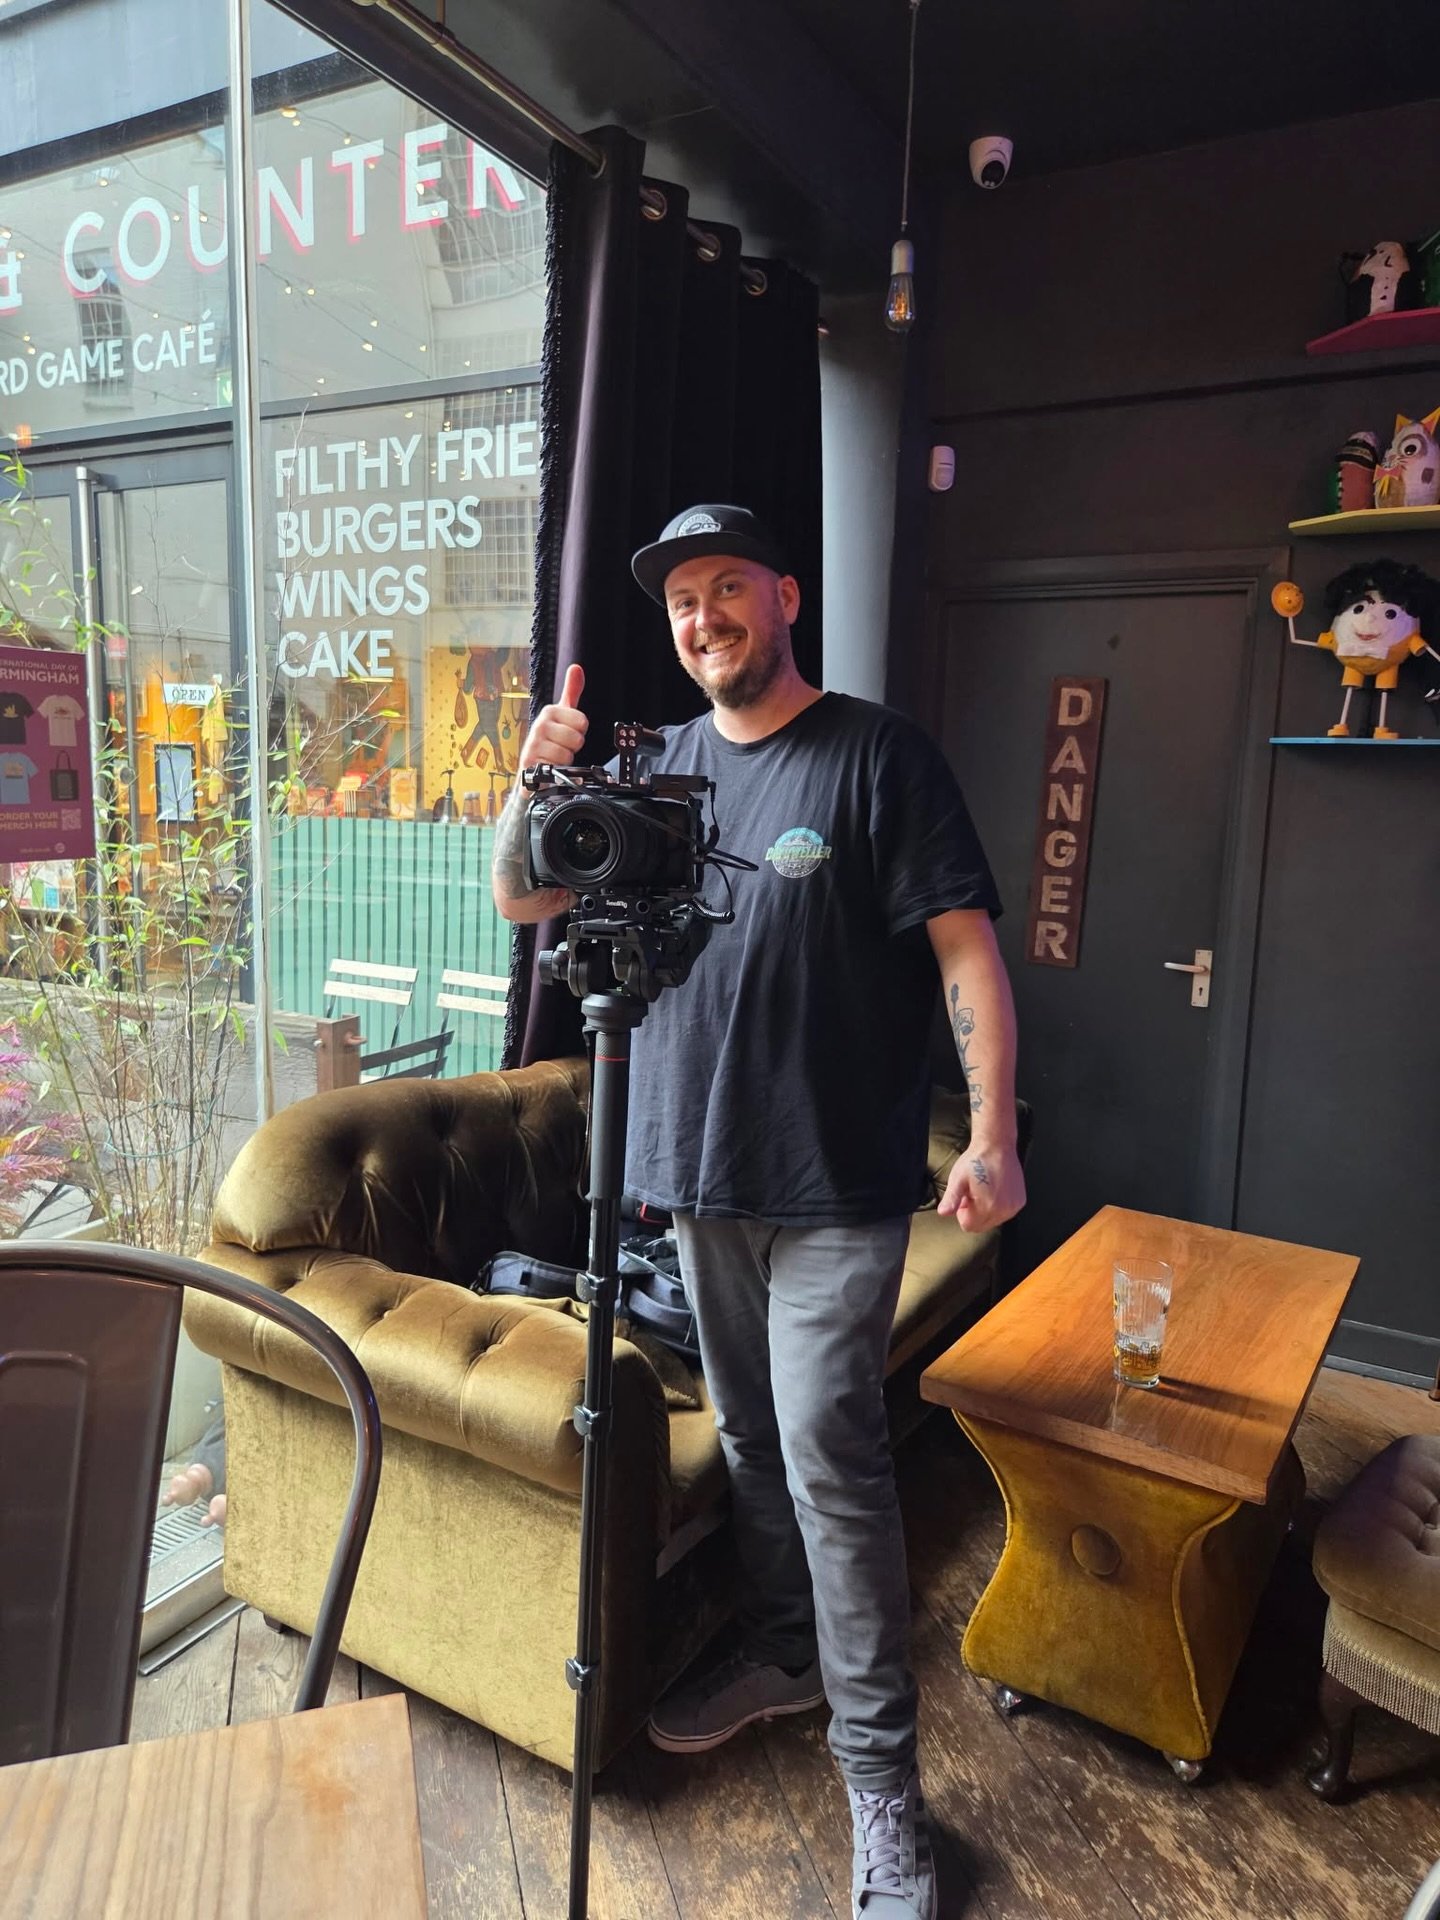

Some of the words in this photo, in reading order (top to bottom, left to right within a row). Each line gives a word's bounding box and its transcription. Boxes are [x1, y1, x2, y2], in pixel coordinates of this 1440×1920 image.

[36, 339, 124, 389] GAME
[132, 308, 217, 373] CAFÉ
[275, 433, 422, 498] FILTHY
[276, 495, 483, 559] BURGERS
[276, 565, 430, 619] WINGS
[277, 630, 395, 679] CAKE
[171, 688, 206, 701] OPEN
[33, 812, 58, 820] YOUR
[1034, 686, 1093, 961] DANGER
